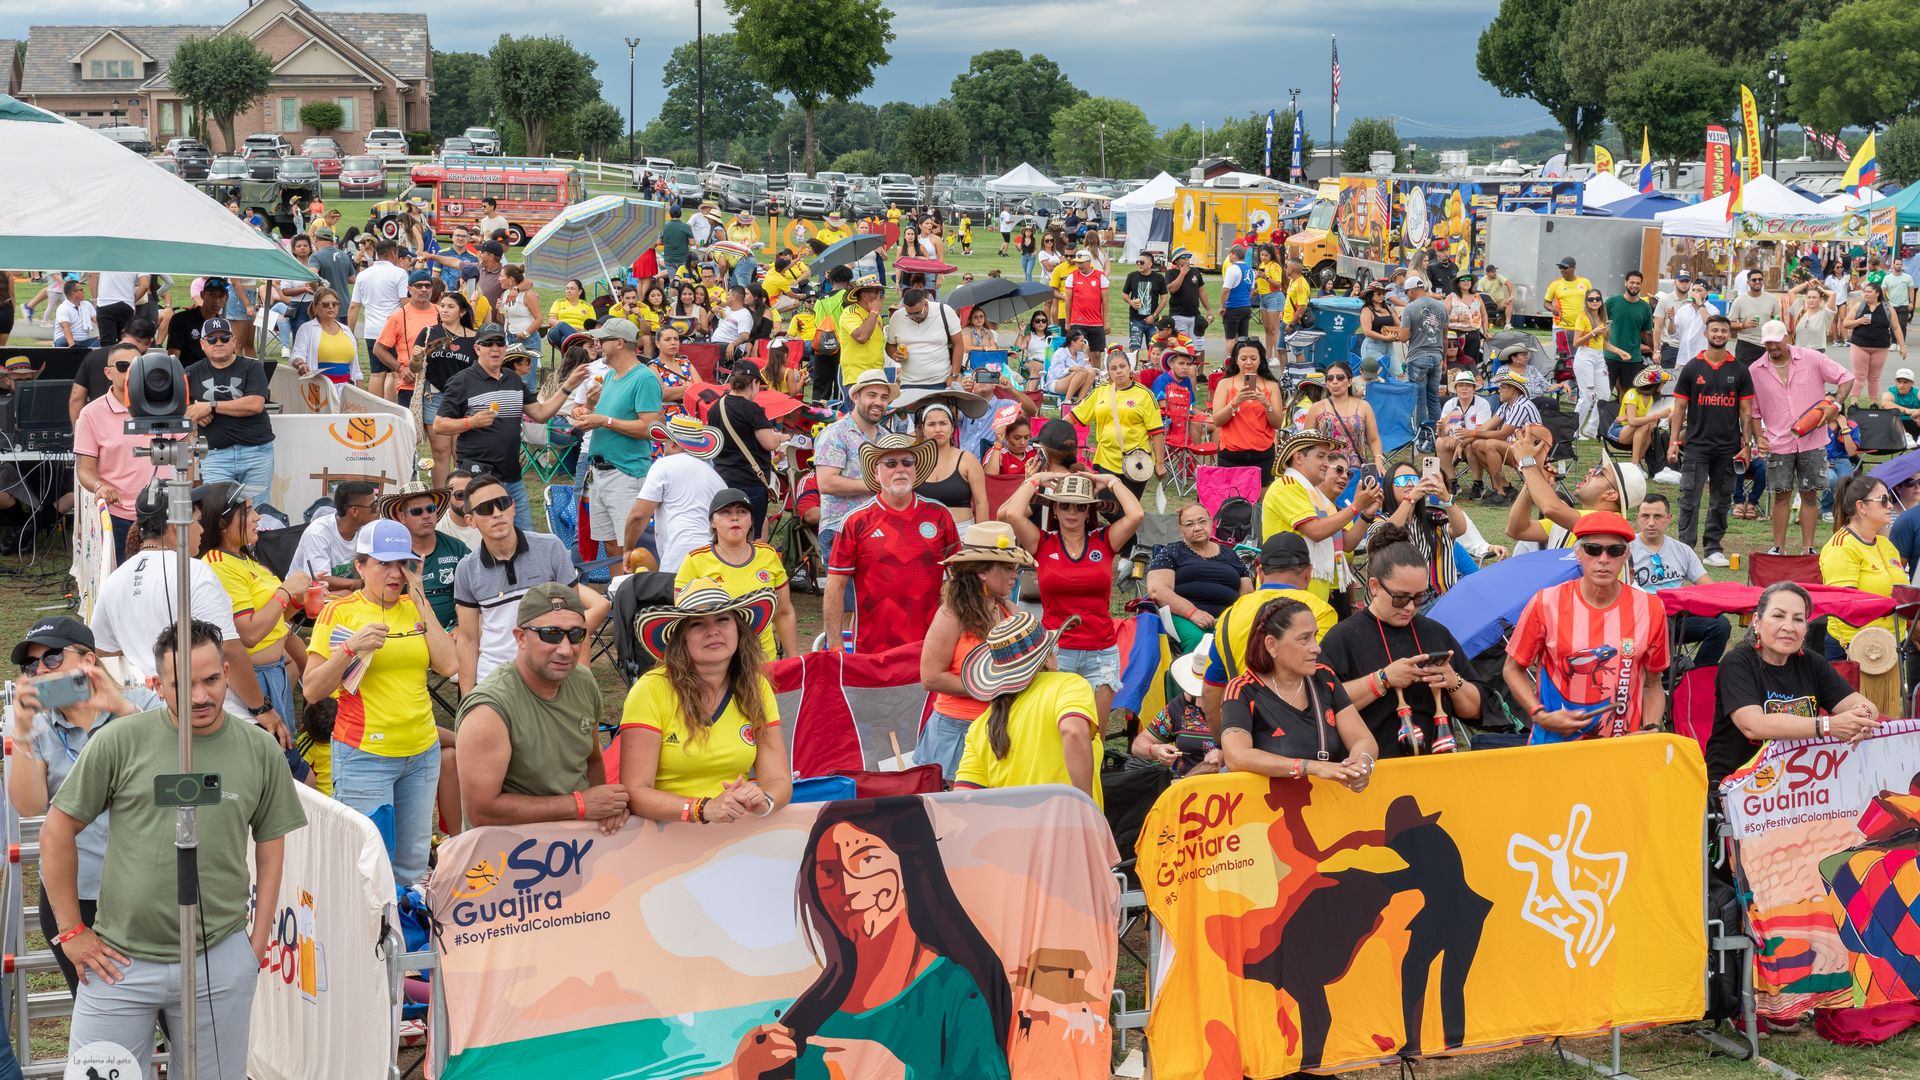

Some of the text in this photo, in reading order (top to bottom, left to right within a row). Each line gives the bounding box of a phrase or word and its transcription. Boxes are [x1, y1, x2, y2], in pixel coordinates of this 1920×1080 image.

[431, 350, 470, 364] COLOMBIA
[1697, 392, 1736, 407] América
[1634, 565, 1682, 587] Dein
[1615, 658, 1633, 715] PUERTO
[1743, 782, 1829, 816] Guainía
[1744, 809, 1859, 834] #SoyFestivalColombiano
[452, 889, 563, 927] Guajira
[454, 911, 611, 946] #SoyFestivalColombiano
